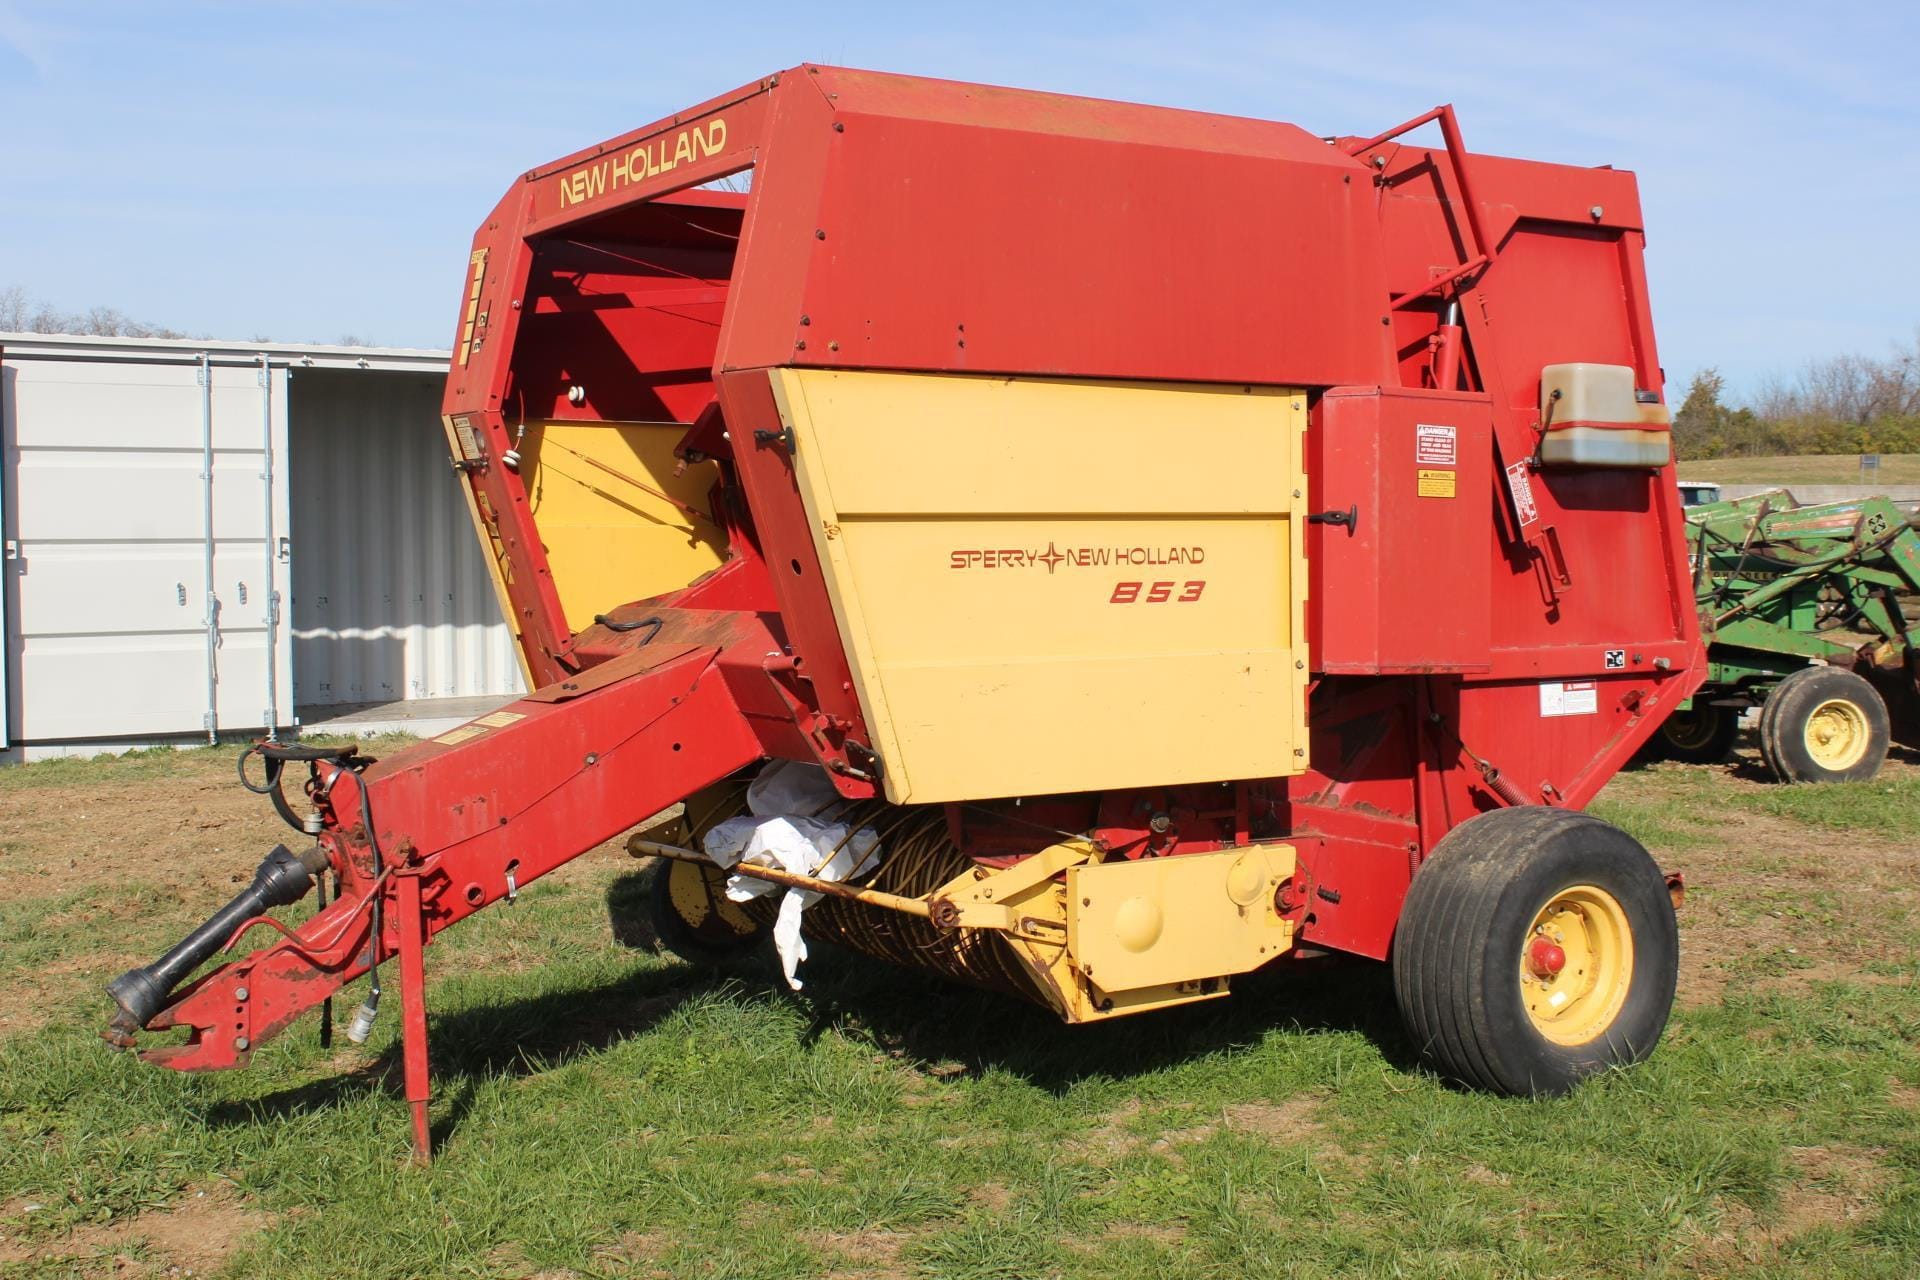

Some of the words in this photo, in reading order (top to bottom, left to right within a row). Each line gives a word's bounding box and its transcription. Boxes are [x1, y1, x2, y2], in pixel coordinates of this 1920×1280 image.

[560, 161, 608, 209] NEW
[612, 118, 727, 190] HOLLAND
[1424, 427, 1448, 435] DANGER
[950, 549, 1038, 569] SPERRY
[1066, 548, 1111, 567] NEW
[1115, 547, 1205, 565] HOLLAND
[1109, 580, 1207, 604] 853
